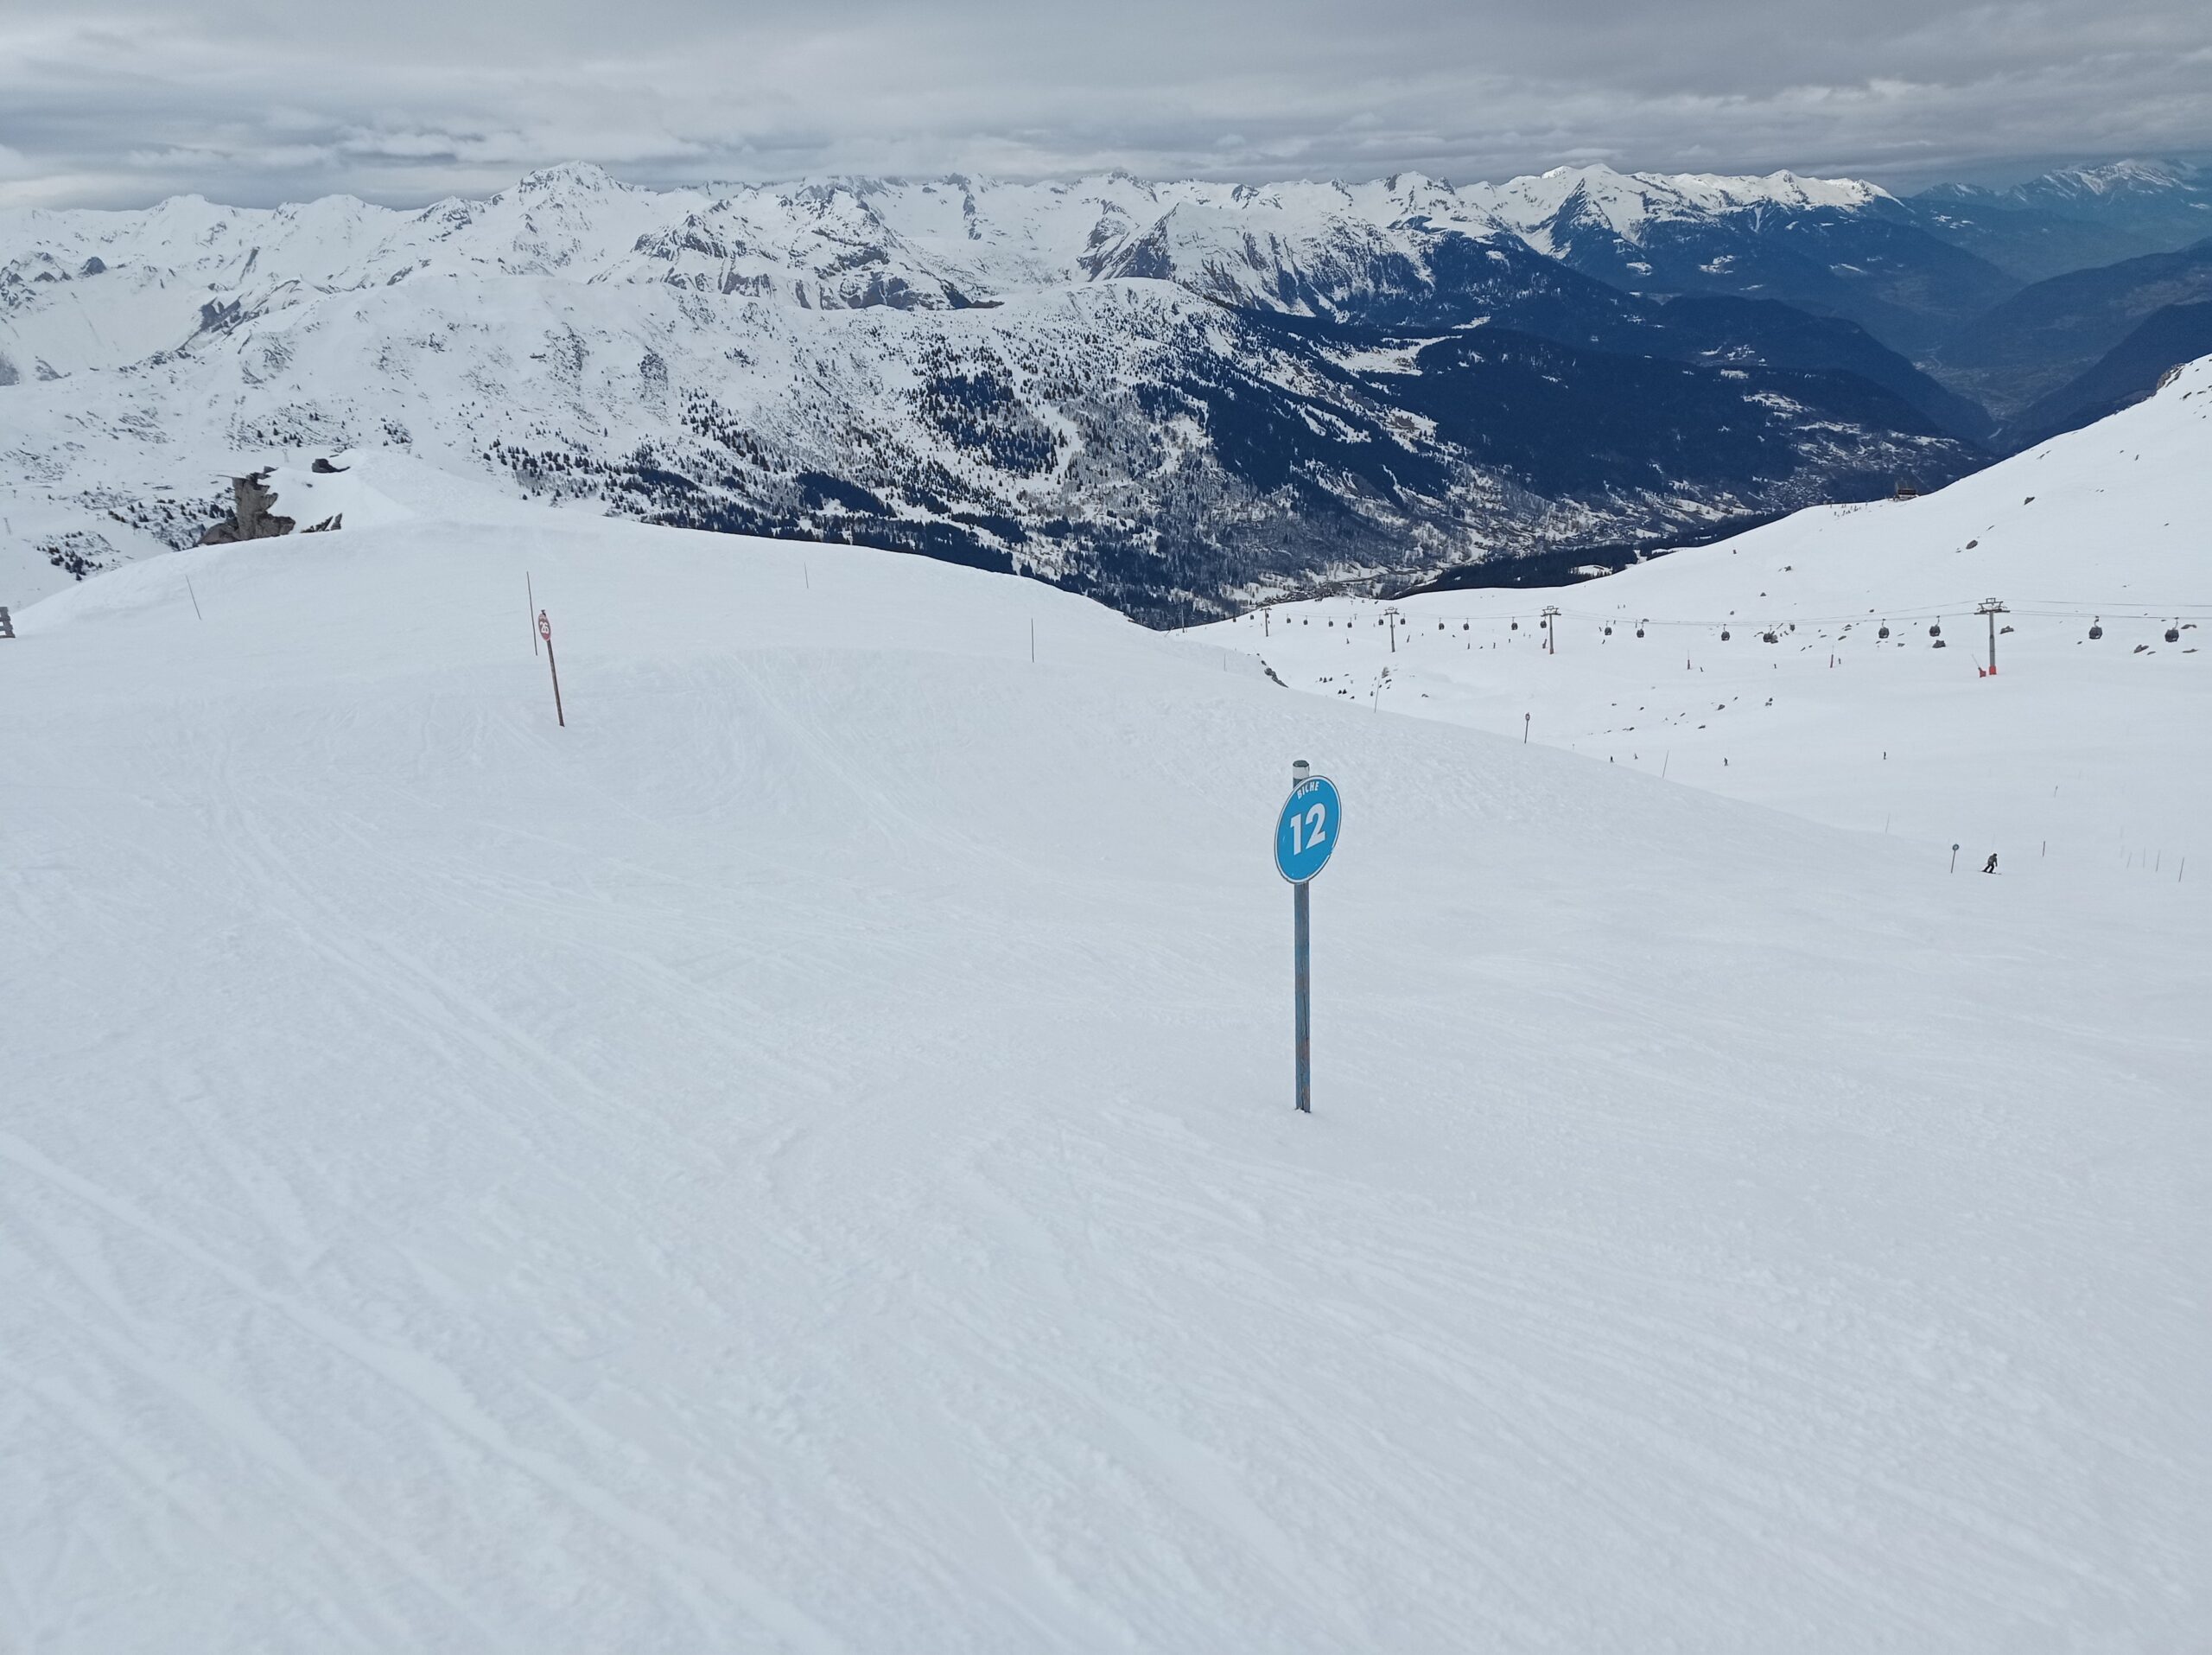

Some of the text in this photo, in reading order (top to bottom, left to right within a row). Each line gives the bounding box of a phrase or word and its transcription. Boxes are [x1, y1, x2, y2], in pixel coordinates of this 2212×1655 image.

[539, 621, 550, 633] 26
[1297, 781, 1319, 799] BICHE
[1290, 803, 1325, 856] 12
